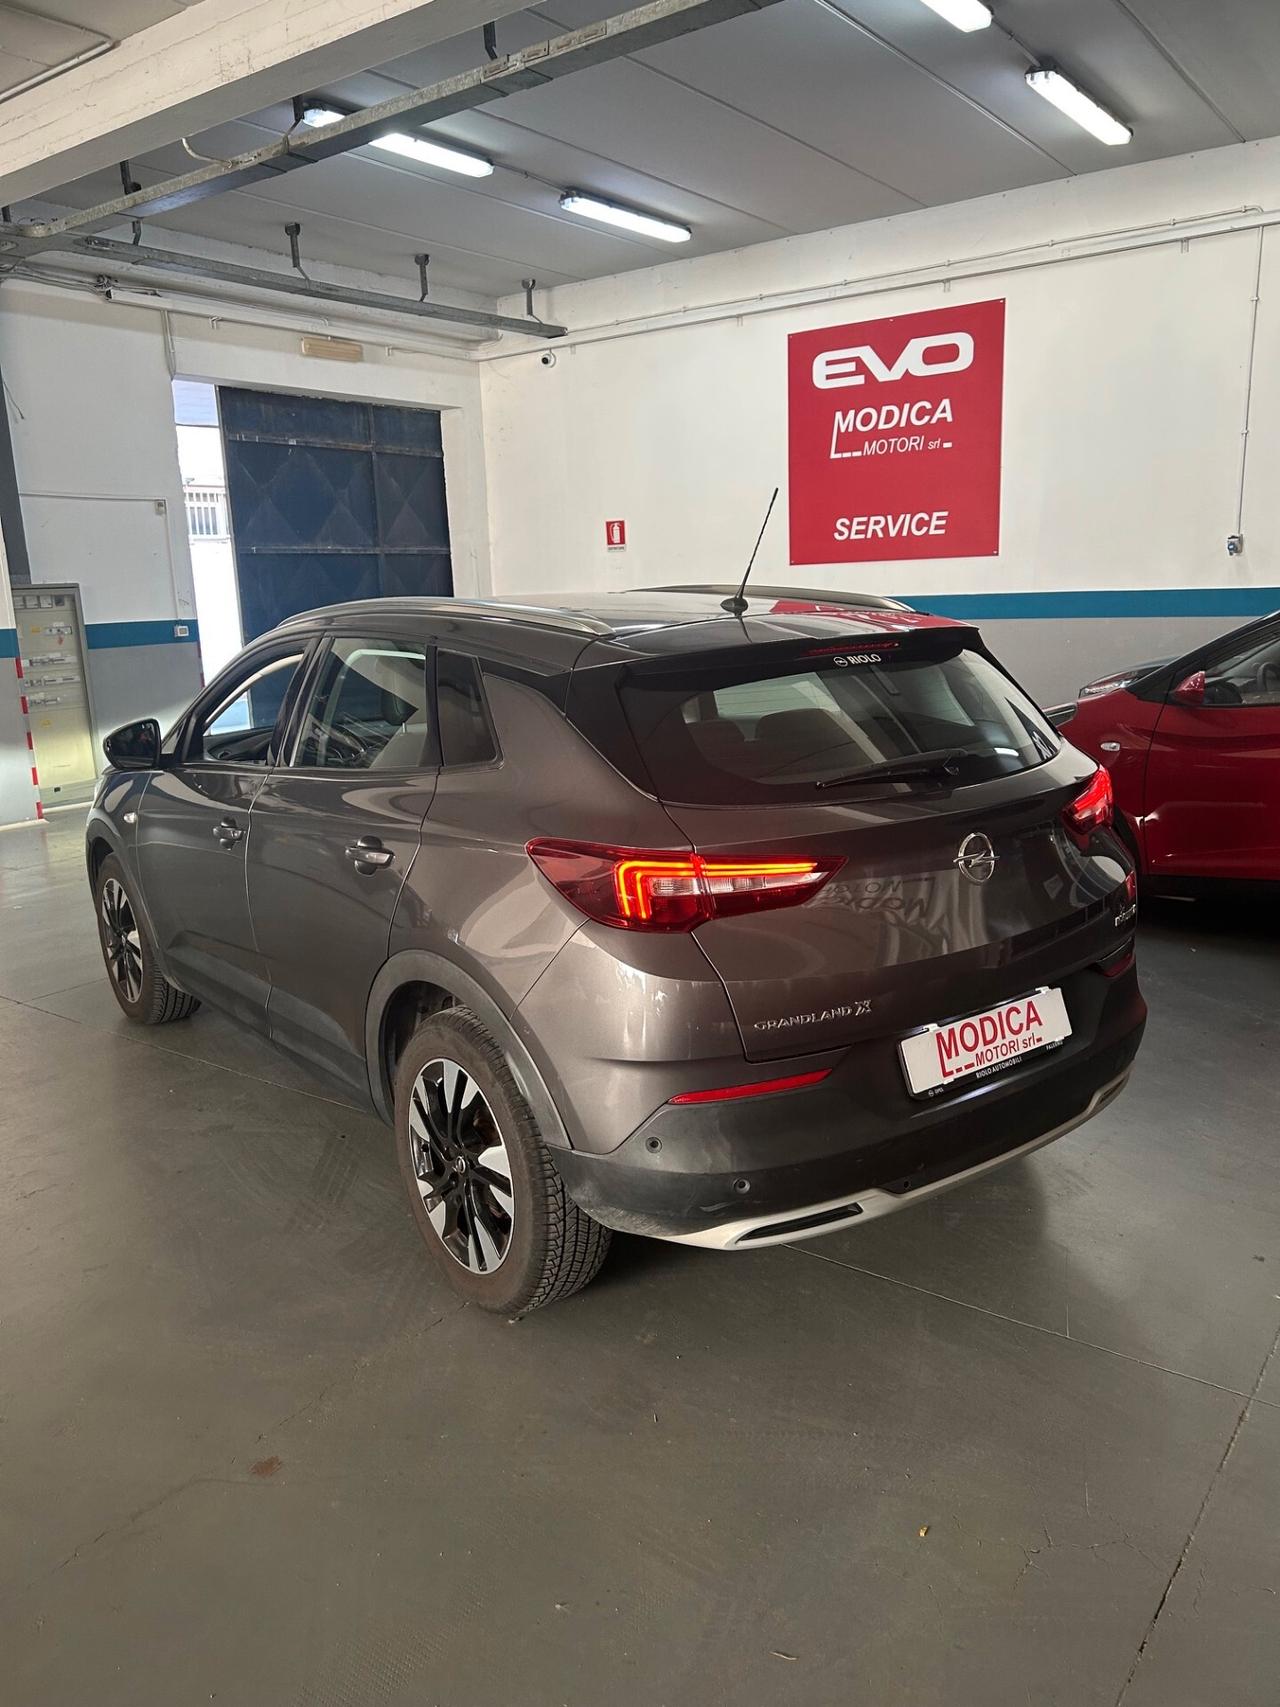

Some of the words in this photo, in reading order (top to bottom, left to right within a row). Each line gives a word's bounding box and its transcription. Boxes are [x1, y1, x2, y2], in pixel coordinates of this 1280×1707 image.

[812, 331, 974, 390] EVO
[834, 398, 953, 434] MODICA
[863, 435, 925, 456] MOTORI
[927, 437, 941, 450] srl
[833, 511, 949, 541] SERVICE
[847, 653, 881, 665] RIOLO
[753, 1005, 853, 1030] GRANDLAND
[936, 1000, 1043, 1061] MODICA
[975, 1038, 1020, 1067] MOTORI
[1022, 1032, 1036, 1049] srl
